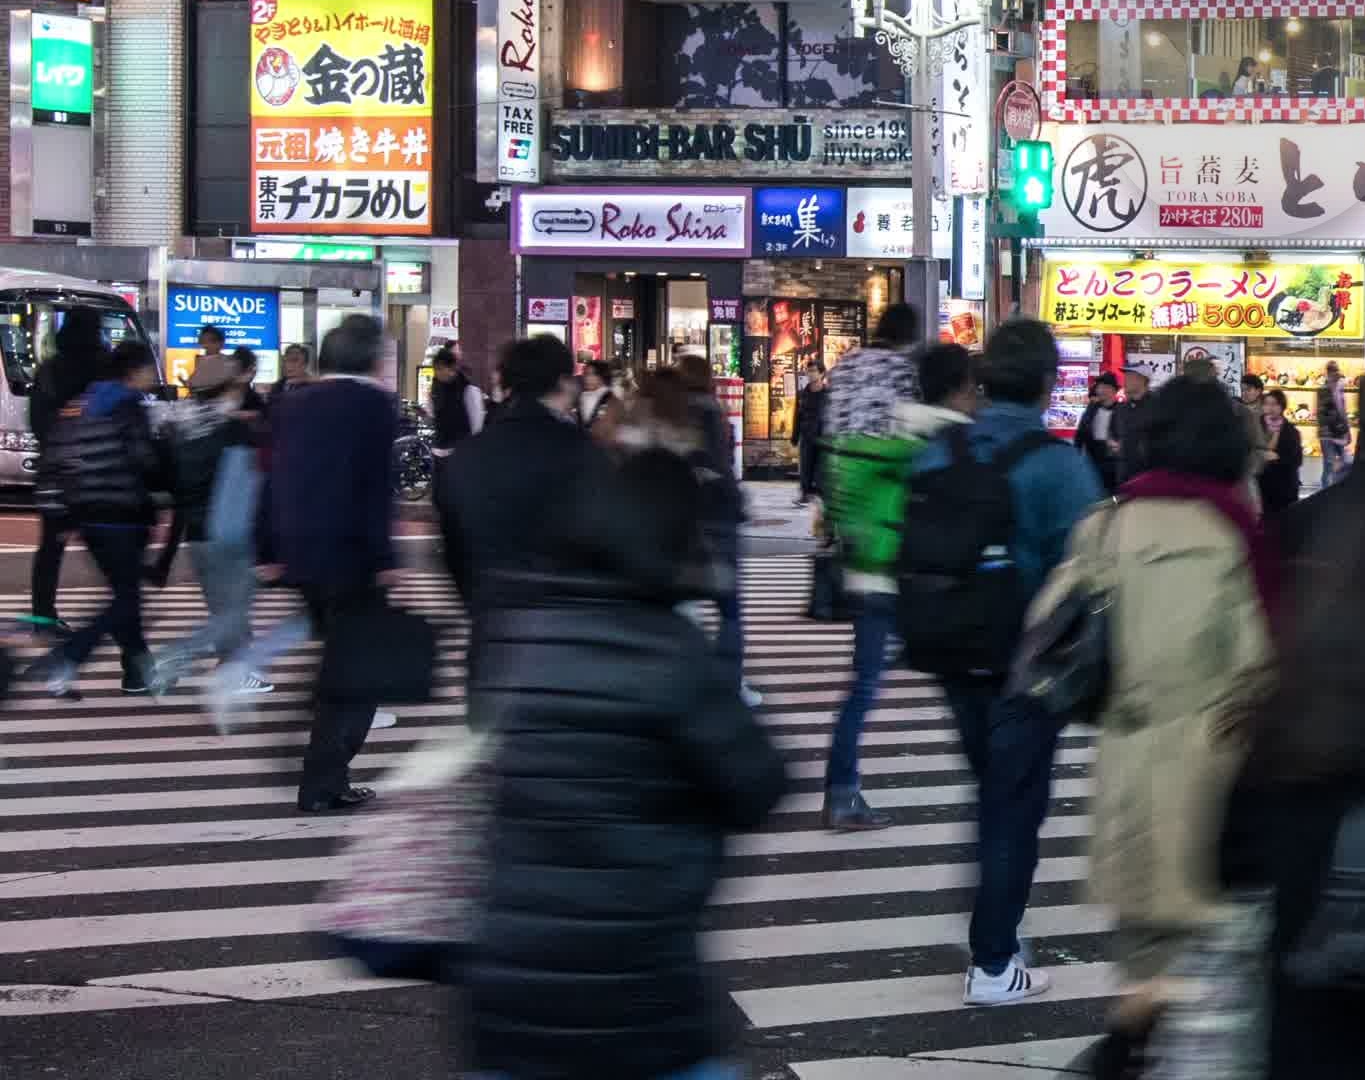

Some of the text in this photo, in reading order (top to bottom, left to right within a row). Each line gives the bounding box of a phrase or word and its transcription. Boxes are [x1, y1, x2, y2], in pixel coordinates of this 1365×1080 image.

[302, 43, 426, 106] 金の蔵
[504, 105, 533, 121] TAX
[504, 121, 534, 136] FREE
[1070, 134, 1137, 230] 虎
[1160, 156, 1259, 186] 旨蕎麦
[259, 176, 426, 221] 東京 チカラめし
[1166, 190, 1258, 204] TORA SOBA
[600, 201, 728, 242] Roko Shira
[792, 194, 821, 249] 集
[1160, 207, 1263, 229] かけそば 280円
[1056, 267, 1278, 299] とんこつラーメン
[175, 294, 265, 315] SUBNADE
[1201, 301, 1275, 329] 500円
